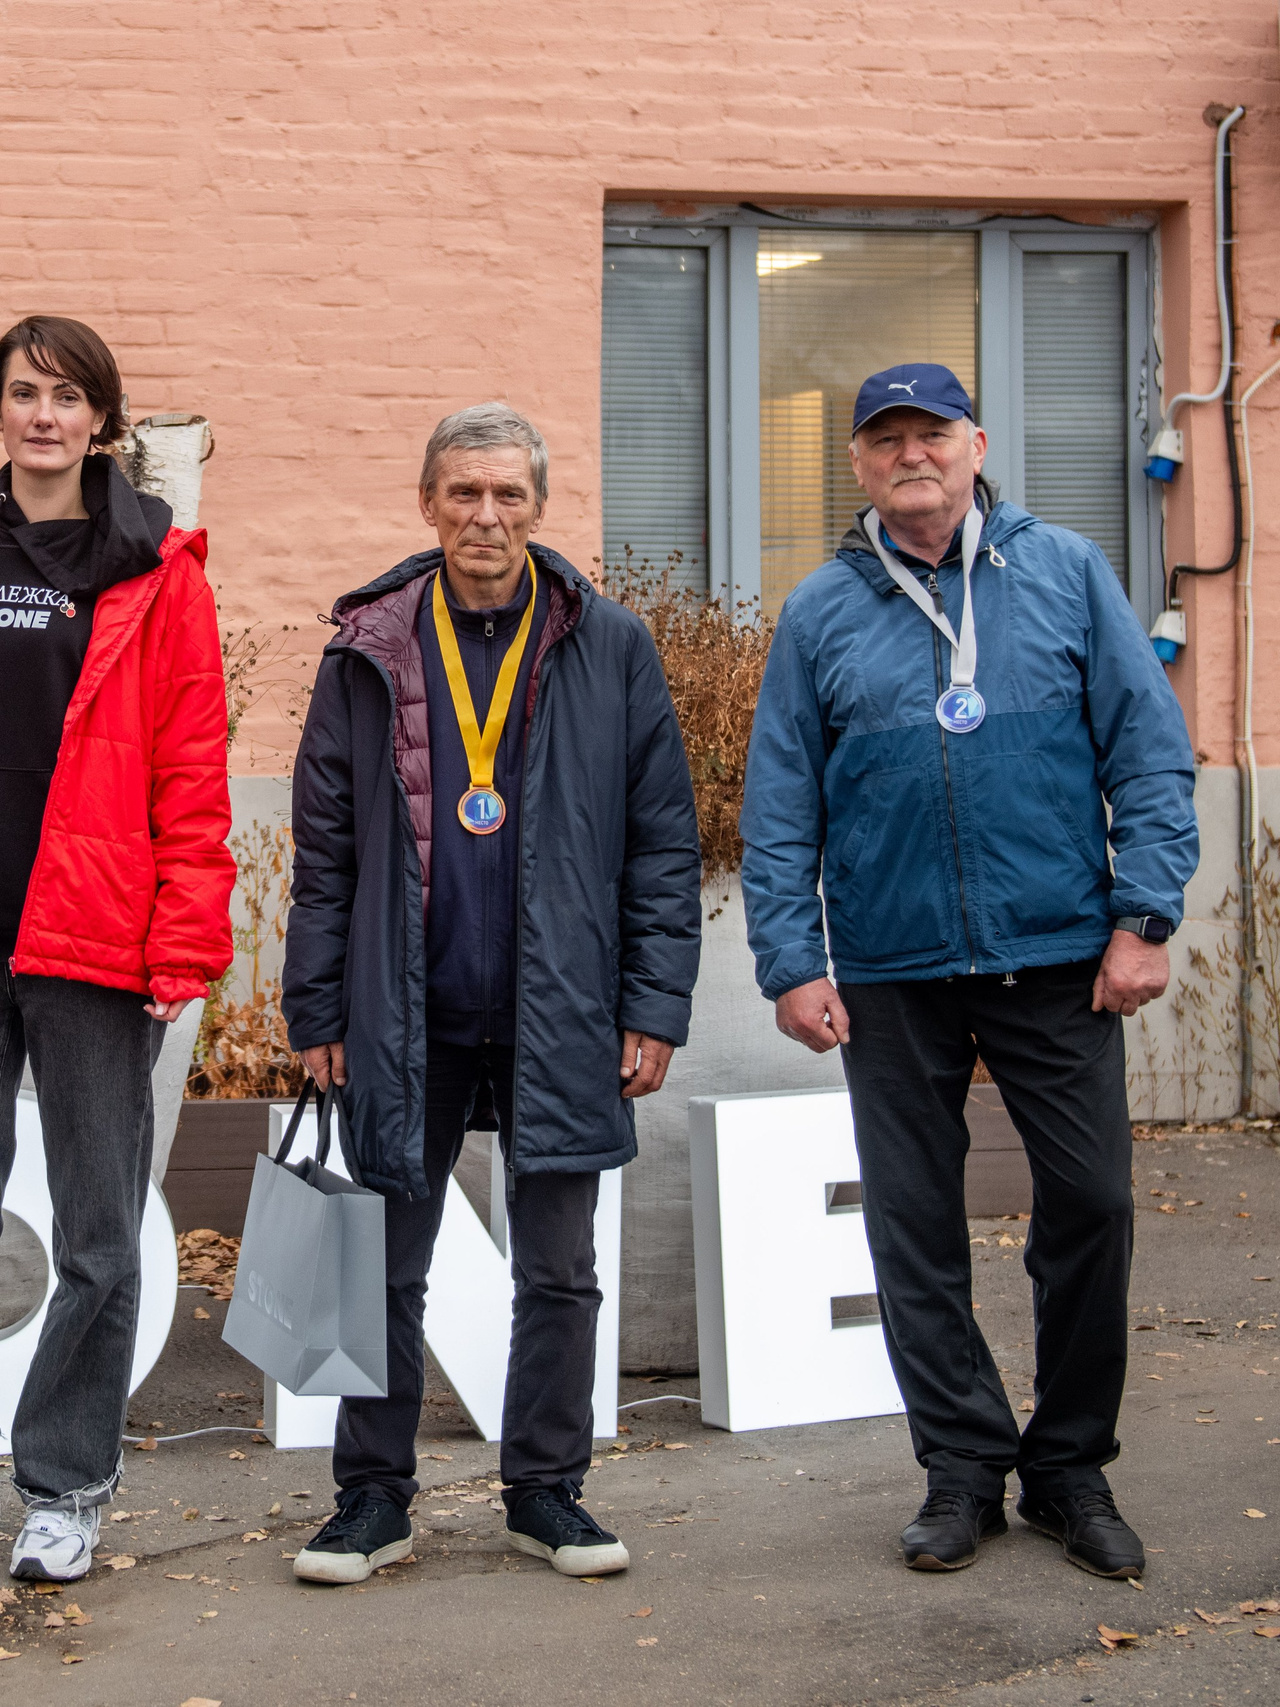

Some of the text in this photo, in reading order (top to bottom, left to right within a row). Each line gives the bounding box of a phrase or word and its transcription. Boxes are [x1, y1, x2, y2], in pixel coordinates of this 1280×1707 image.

[954, 698, 968, 719] 2
[477, 798, 486, 820] 1
[247, 1269, 293, 1331] STONE
